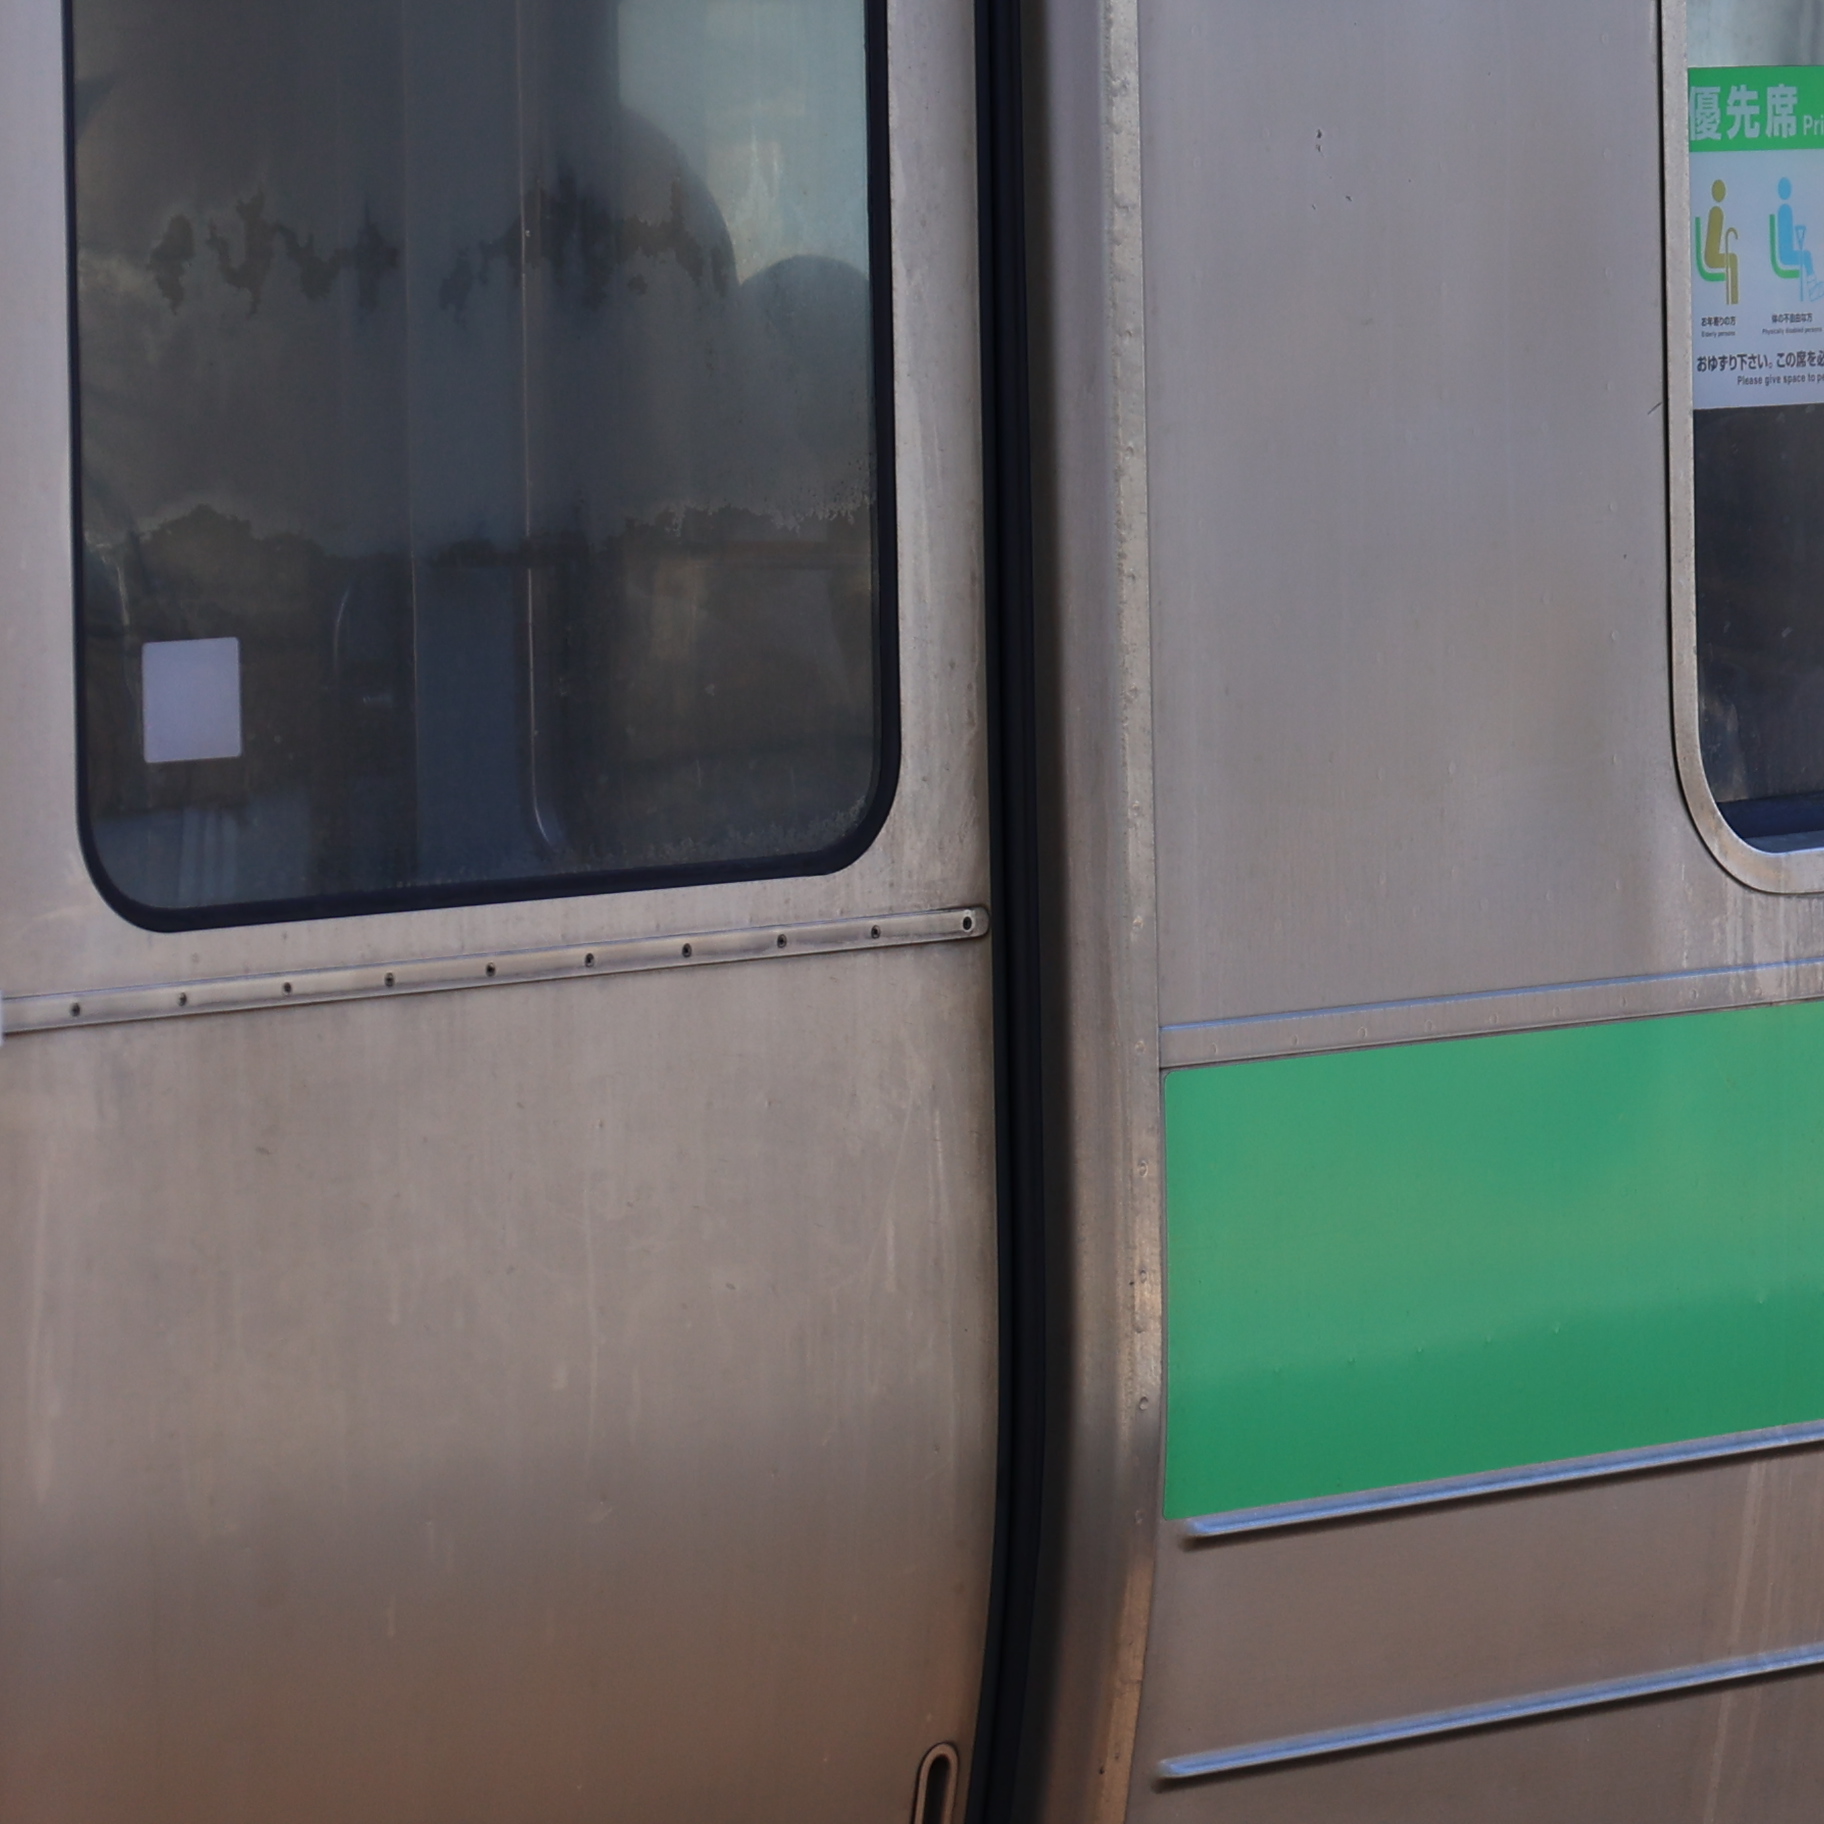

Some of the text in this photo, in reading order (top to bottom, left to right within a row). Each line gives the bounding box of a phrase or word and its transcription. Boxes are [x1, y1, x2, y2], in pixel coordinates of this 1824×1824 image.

[1687, 83, 1799, 141] 優先席
[1737, 375, 1762, 386] Please
[1764, 374, 1781, 387] give
[1783, 374, 1806, 385] space
[1807, 373, 1816, 382] to
